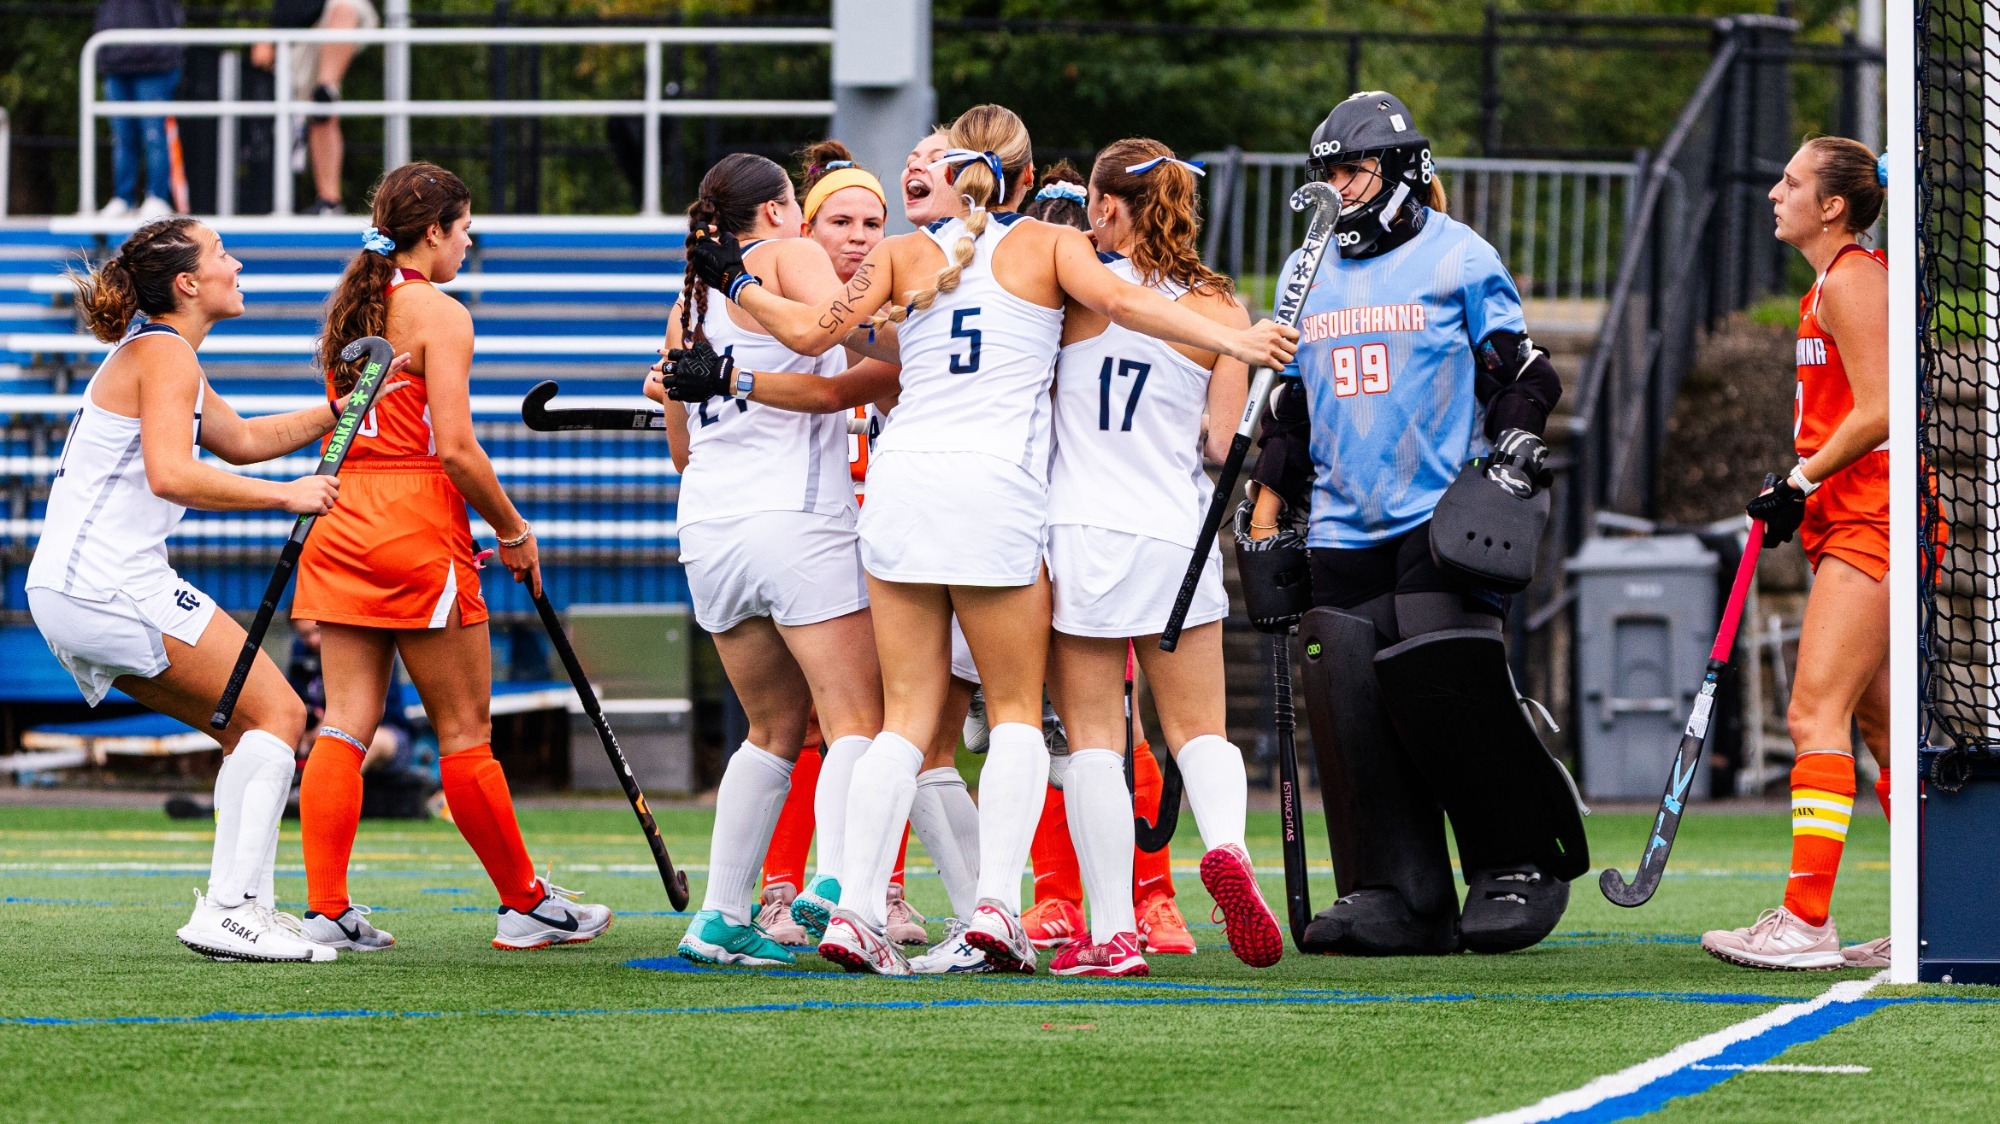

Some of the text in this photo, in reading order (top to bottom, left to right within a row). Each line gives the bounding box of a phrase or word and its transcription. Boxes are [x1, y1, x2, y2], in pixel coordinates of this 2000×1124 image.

[1313, 140, 1341, 157] OBO
[1421, 149, 1432, 184] OBO
[1275, 282, 1306, 328] AKA
[1301, 303, 1427, 345] SUSQUEHANNA
[949, 306, 982, 375] 5
[361, 361, 382, 388] 大阪
[1331, 342, 1391, 398] 99
[1098, 356, 1152, 432] 17
[323, 415, 359, 463] OSAKA
[1307, 643, 1321, 655] OBO
[221, 917, 260, 944] OSAKA
